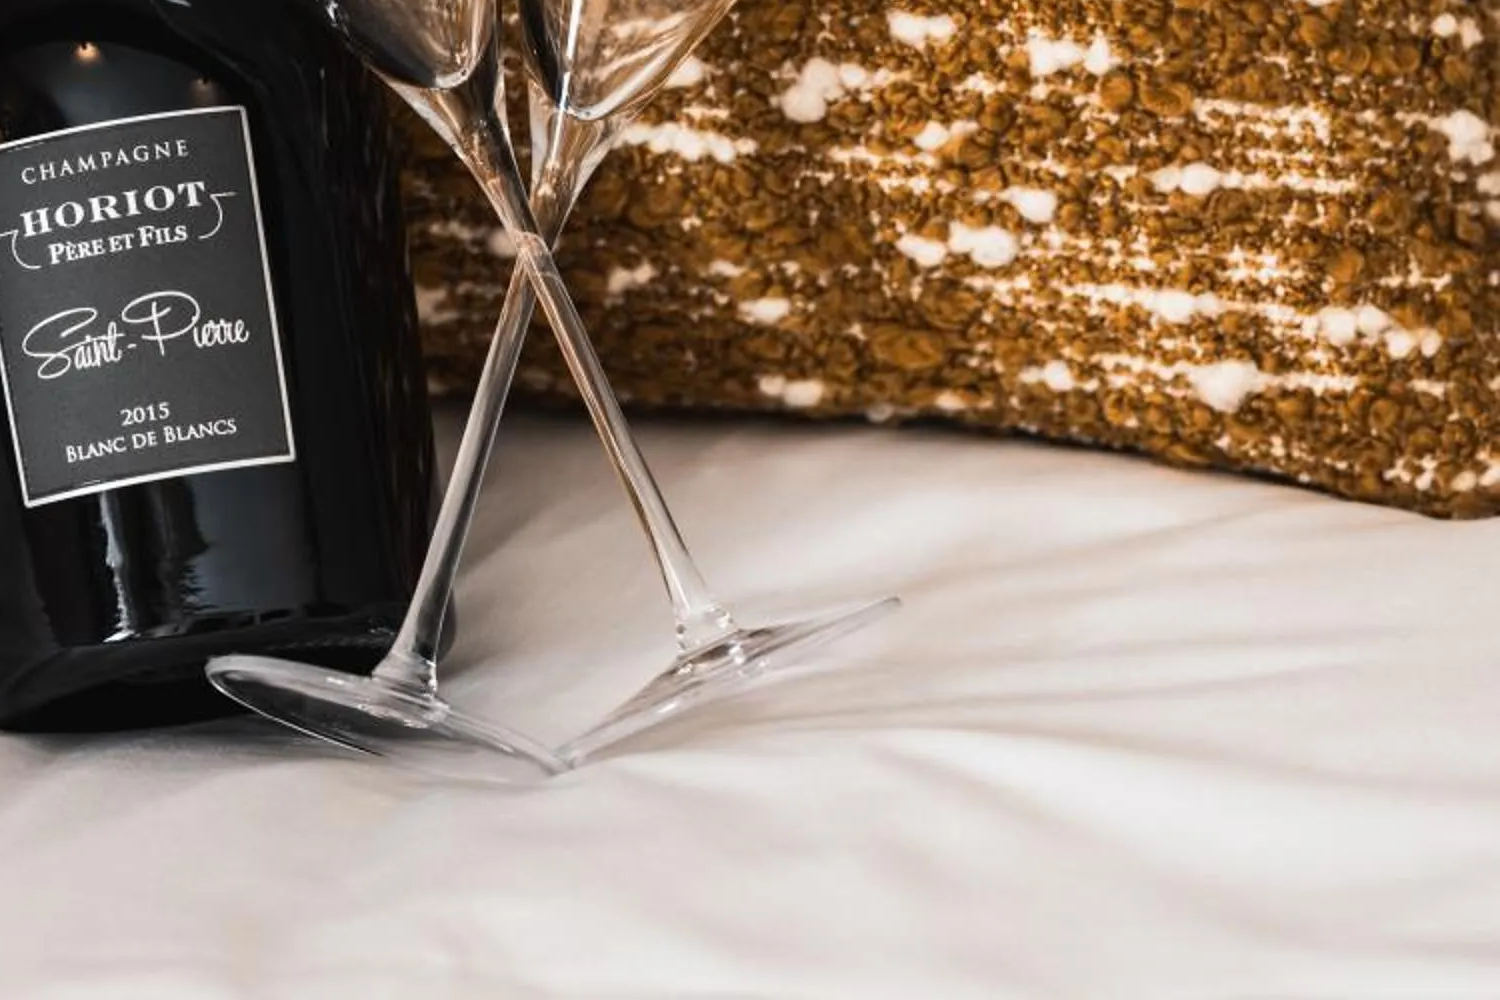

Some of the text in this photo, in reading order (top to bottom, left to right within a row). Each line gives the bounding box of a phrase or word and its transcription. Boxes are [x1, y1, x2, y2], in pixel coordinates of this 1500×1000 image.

[21, 139, 190, 185] CHAMPAGNE
[20, 181, 205, 237] HORIOT
[120, 402, 171, 426] 2015
